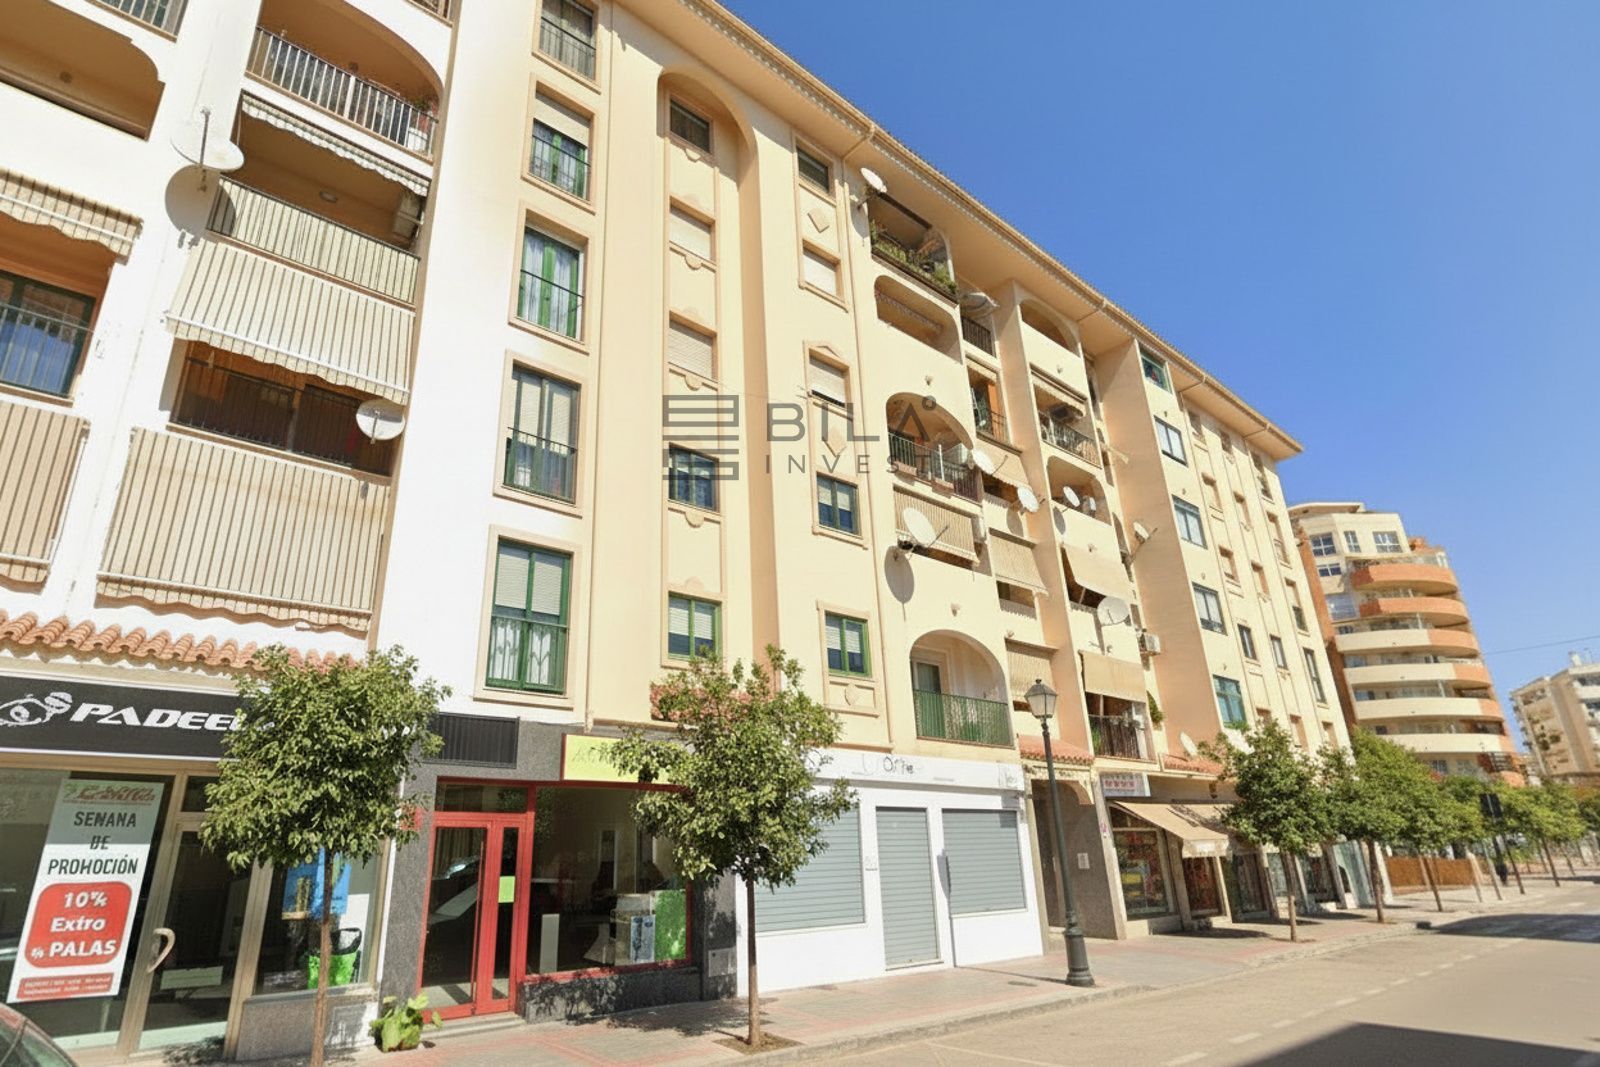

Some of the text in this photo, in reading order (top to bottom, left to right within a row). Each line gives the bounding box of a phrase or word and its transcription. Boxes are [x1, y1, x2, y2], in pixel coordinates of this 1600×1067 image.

[73, 811, 137, 828] SEMANA
[89, 835, 111, 850] DE
[47, 854, 139, 875] PROMOCIÓN
[64, 891, 108, 909] 10%
[49, 940, 117, 958] PALAS
